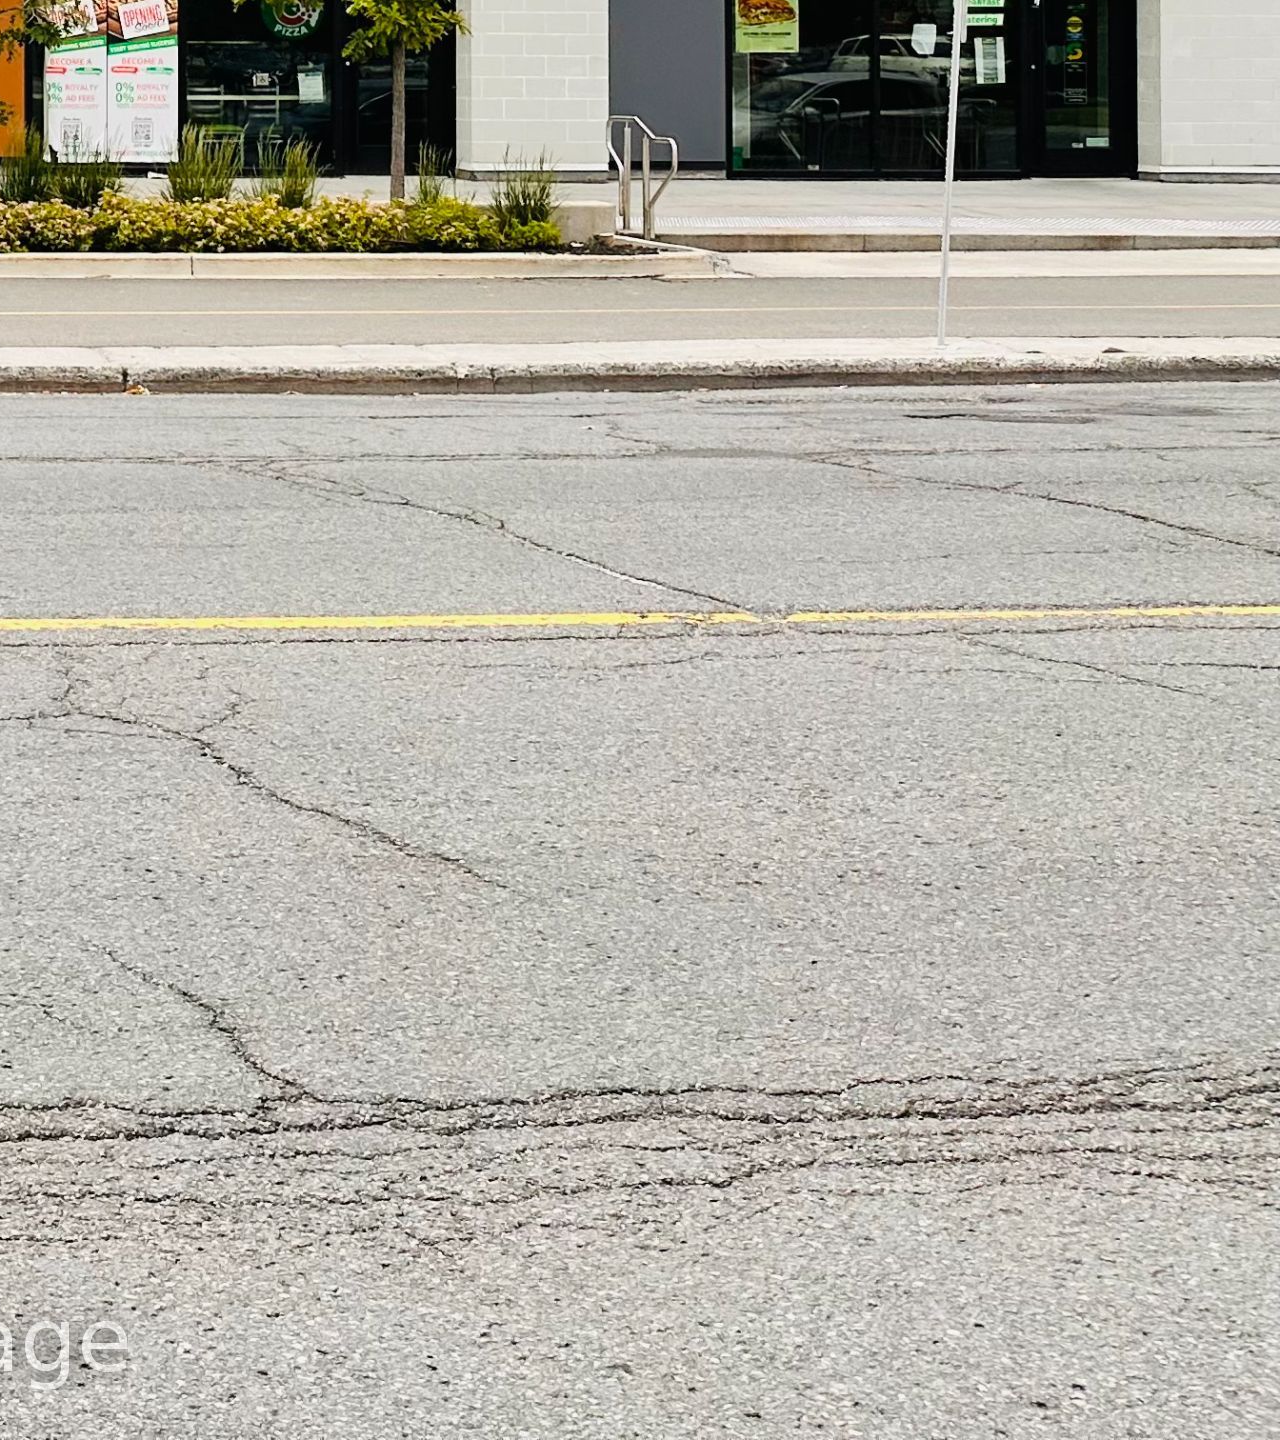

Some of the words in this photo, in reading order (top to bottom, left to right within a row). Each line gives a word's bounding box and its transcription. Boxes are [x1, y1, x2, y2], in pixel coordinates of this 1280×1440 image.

[123, 3, 163, 27] OPENING
[274, 23, 309, 37] PIZZA
[116, 82, 135, 93] 0%
[116, 92, 135, 103] 0%
